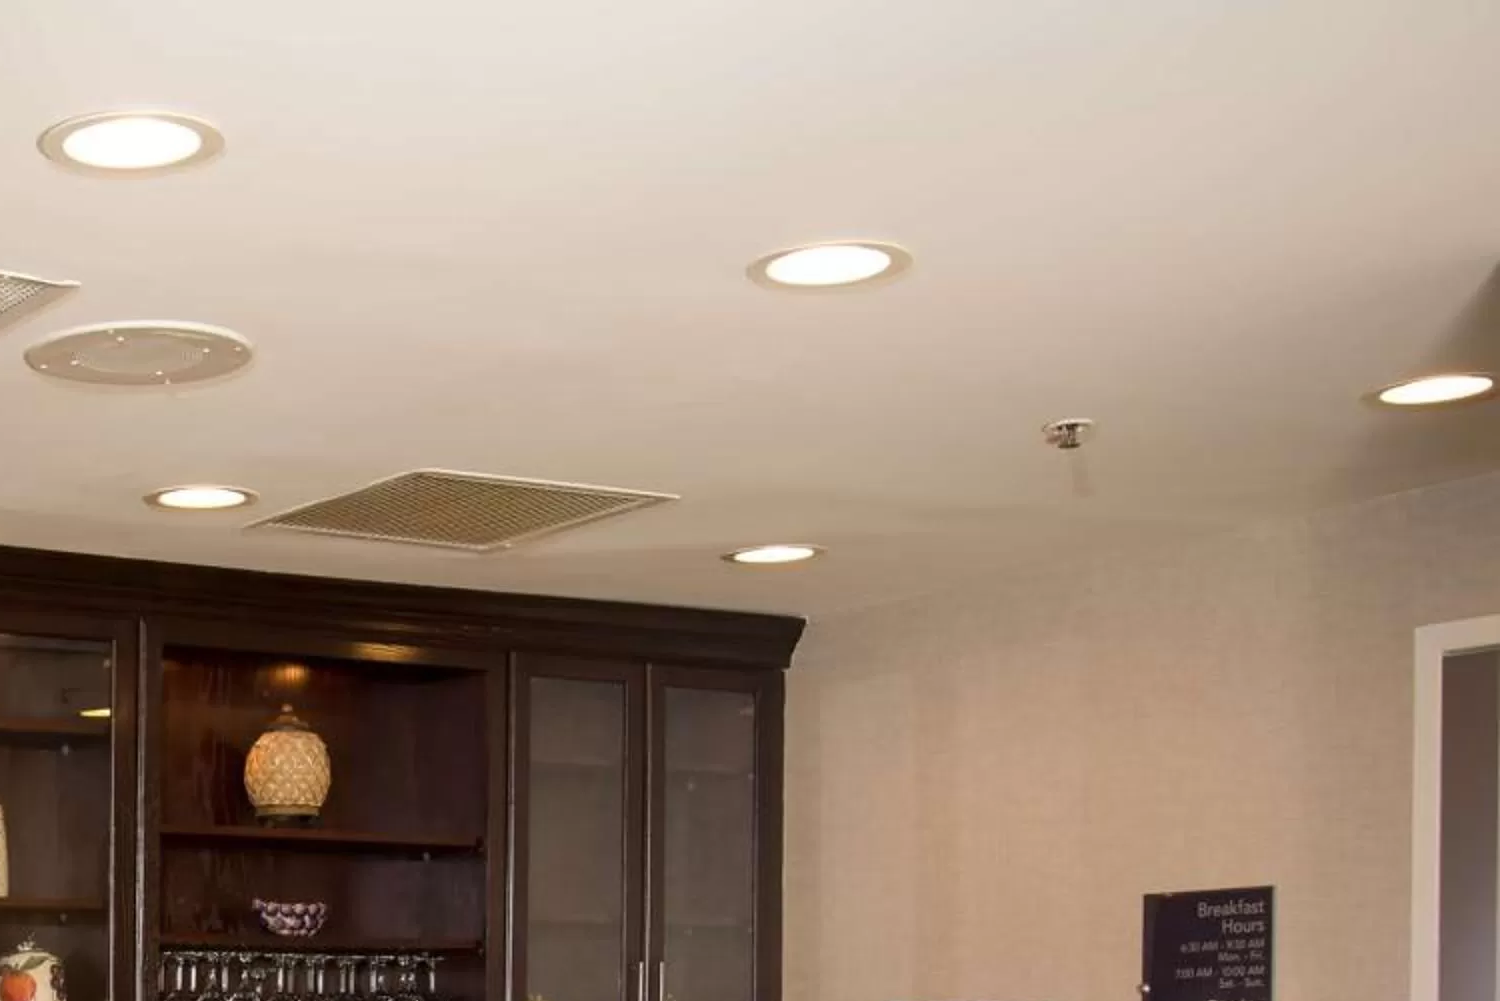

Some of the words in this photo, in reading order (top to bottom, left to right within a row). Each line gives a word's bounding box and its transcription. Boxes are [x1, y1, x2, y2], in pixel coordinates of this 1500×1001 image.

[1197, 900, 1265, 918] Breakfast
[1221, 919, 1265, 934] Hours
[1247, 938, 1265, 949] AM
[1247, 965, 1265, 977] AM
